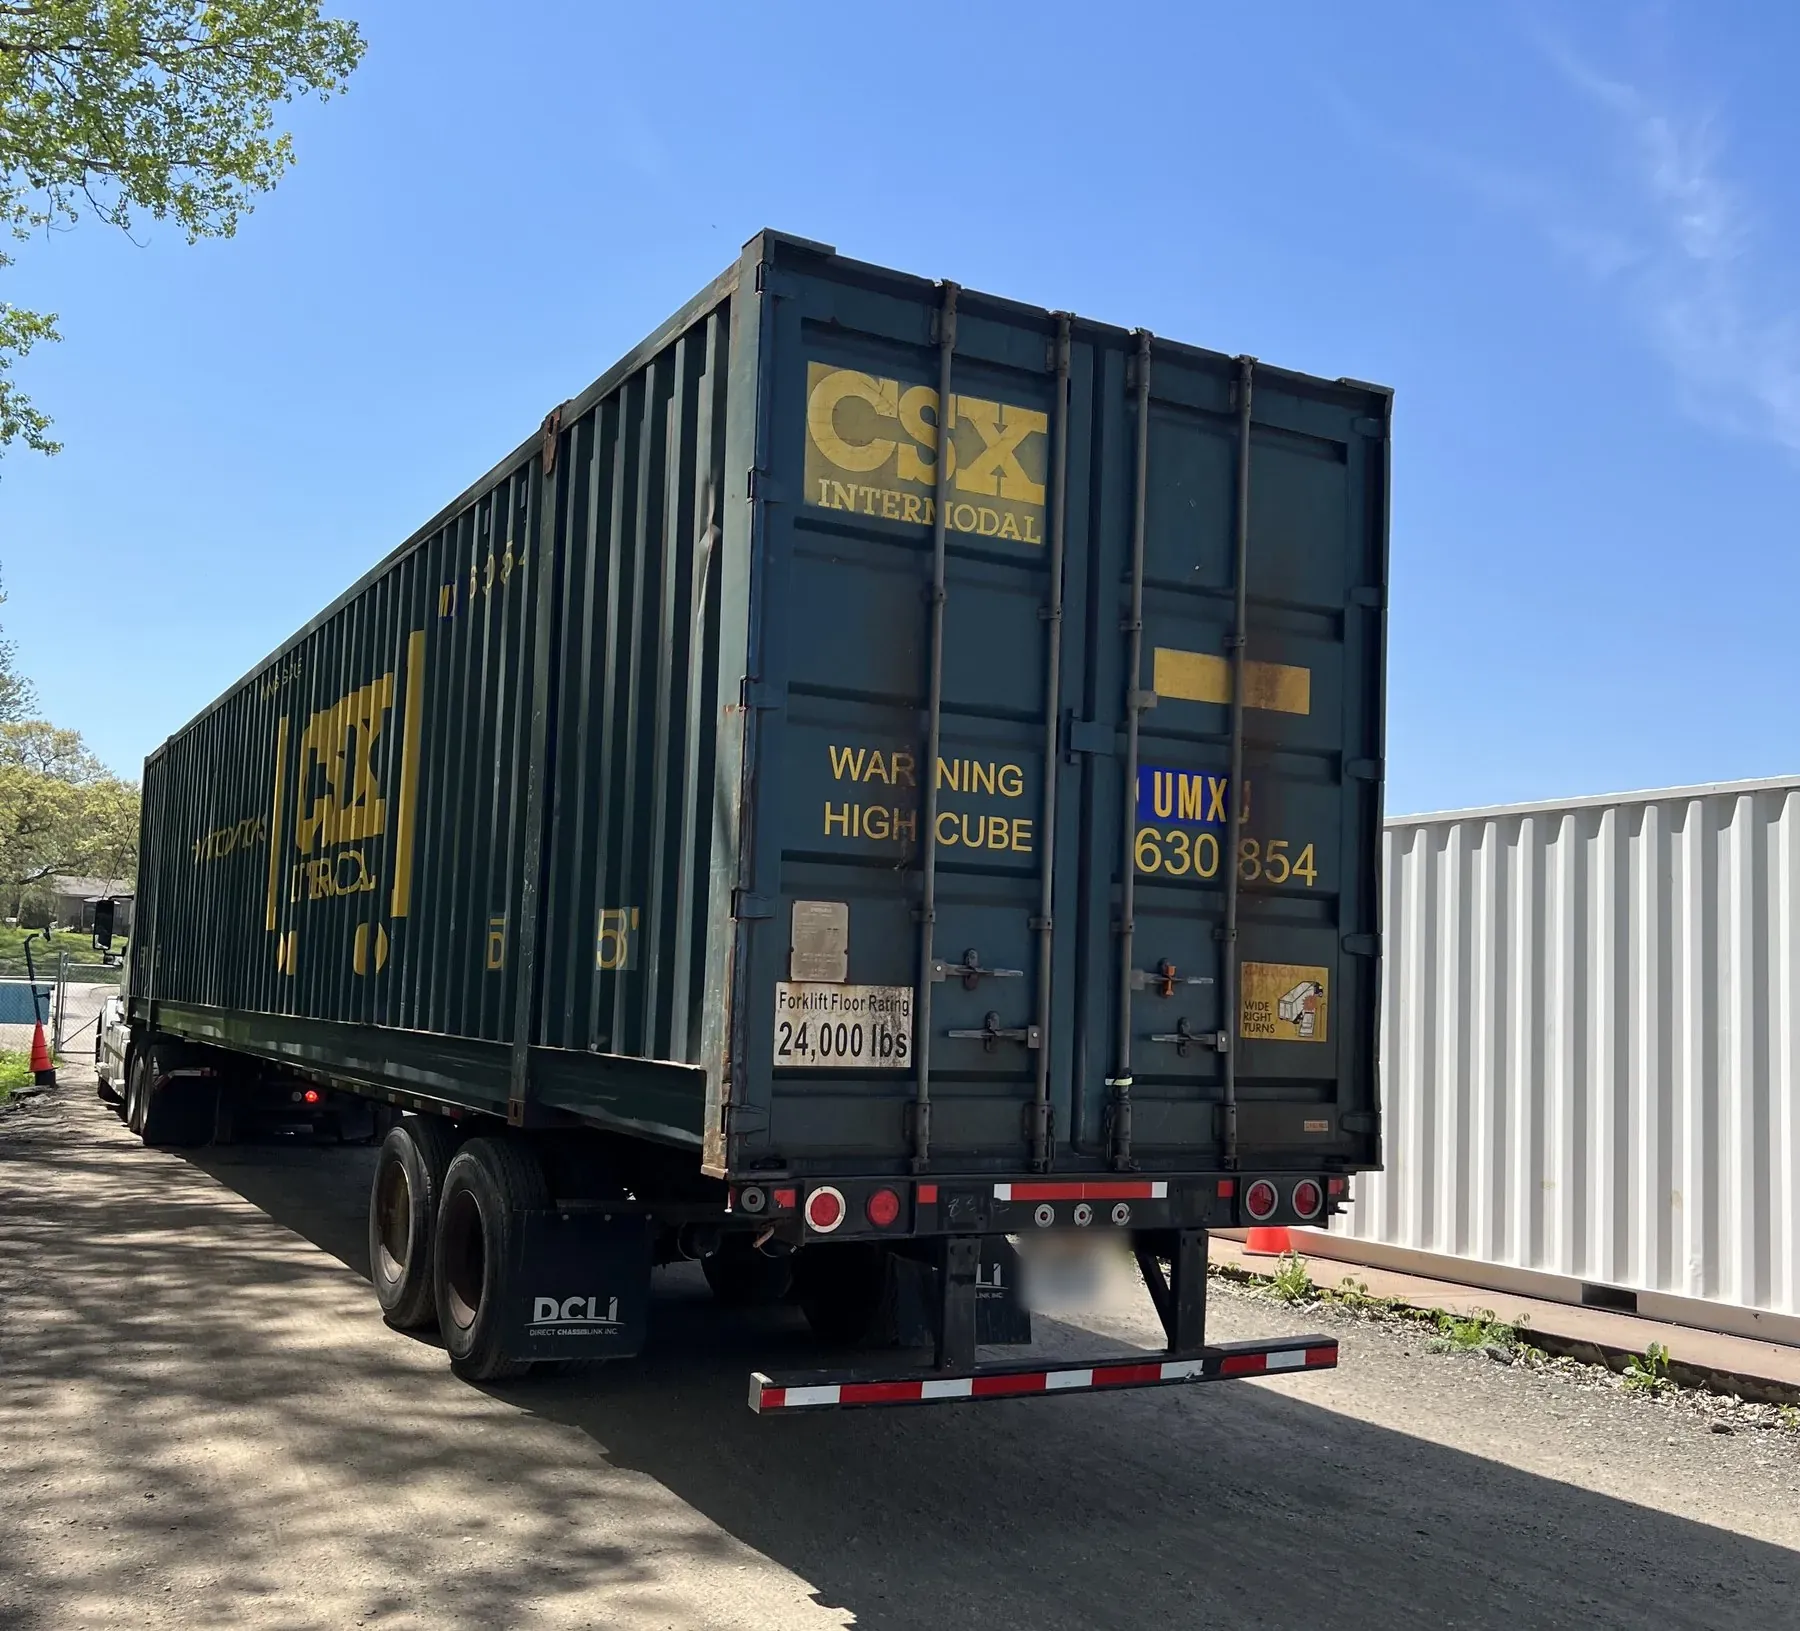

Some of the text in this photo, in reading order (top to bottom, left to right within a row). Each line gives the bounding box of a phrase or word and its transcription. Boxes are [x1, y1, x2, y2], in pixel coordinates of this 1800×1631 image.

[807, 369, 1047, 506] CSX
[818, 478, 1041, 545] INTERMODAL
[829, 745, 1024, 797] WARNING
[824, 801, 1033, 851] HIGH CUBE
[779, 991, 909, 1017] Forklift Floor Rating
[1243, 1012, 1272, 1022] RIGHT
[1244, 1001, 1270, 1011] WIDE
[778, 1021, 908, 1062] 24,000 lbs
[1243, 1022, 1275, 1033] TURNS
